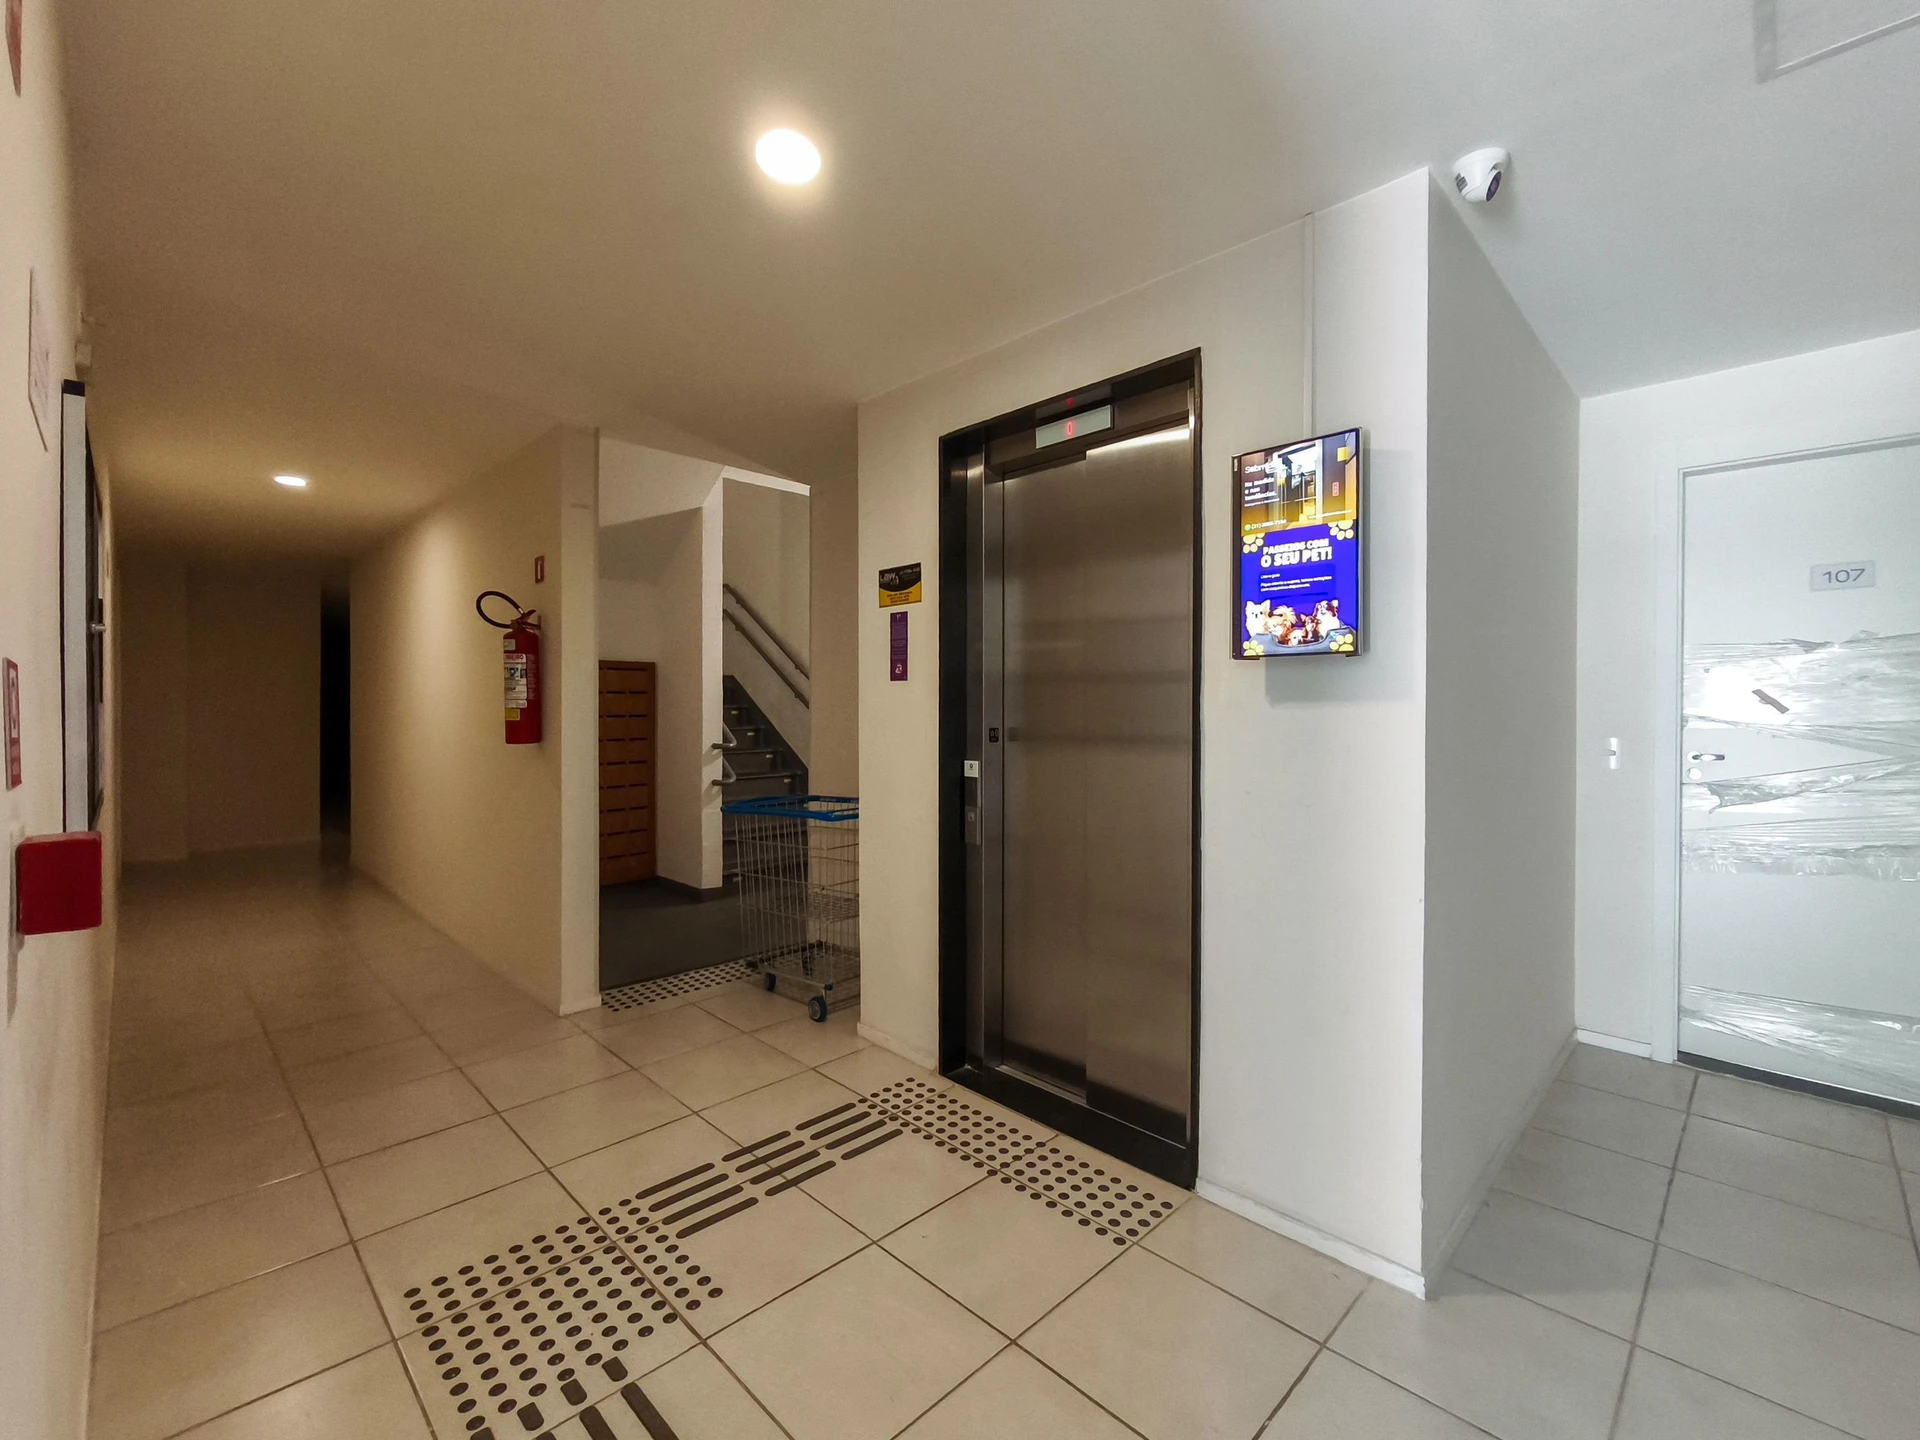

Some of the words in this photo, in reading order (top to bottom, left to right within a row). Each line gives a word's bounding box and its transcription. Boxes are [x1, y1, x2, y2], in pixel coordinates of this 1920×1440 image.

[1261, 555, 1271, 567] O
[1274, 551, 1300, 566] SEU
[1822, 568, 1865, 584] 107
